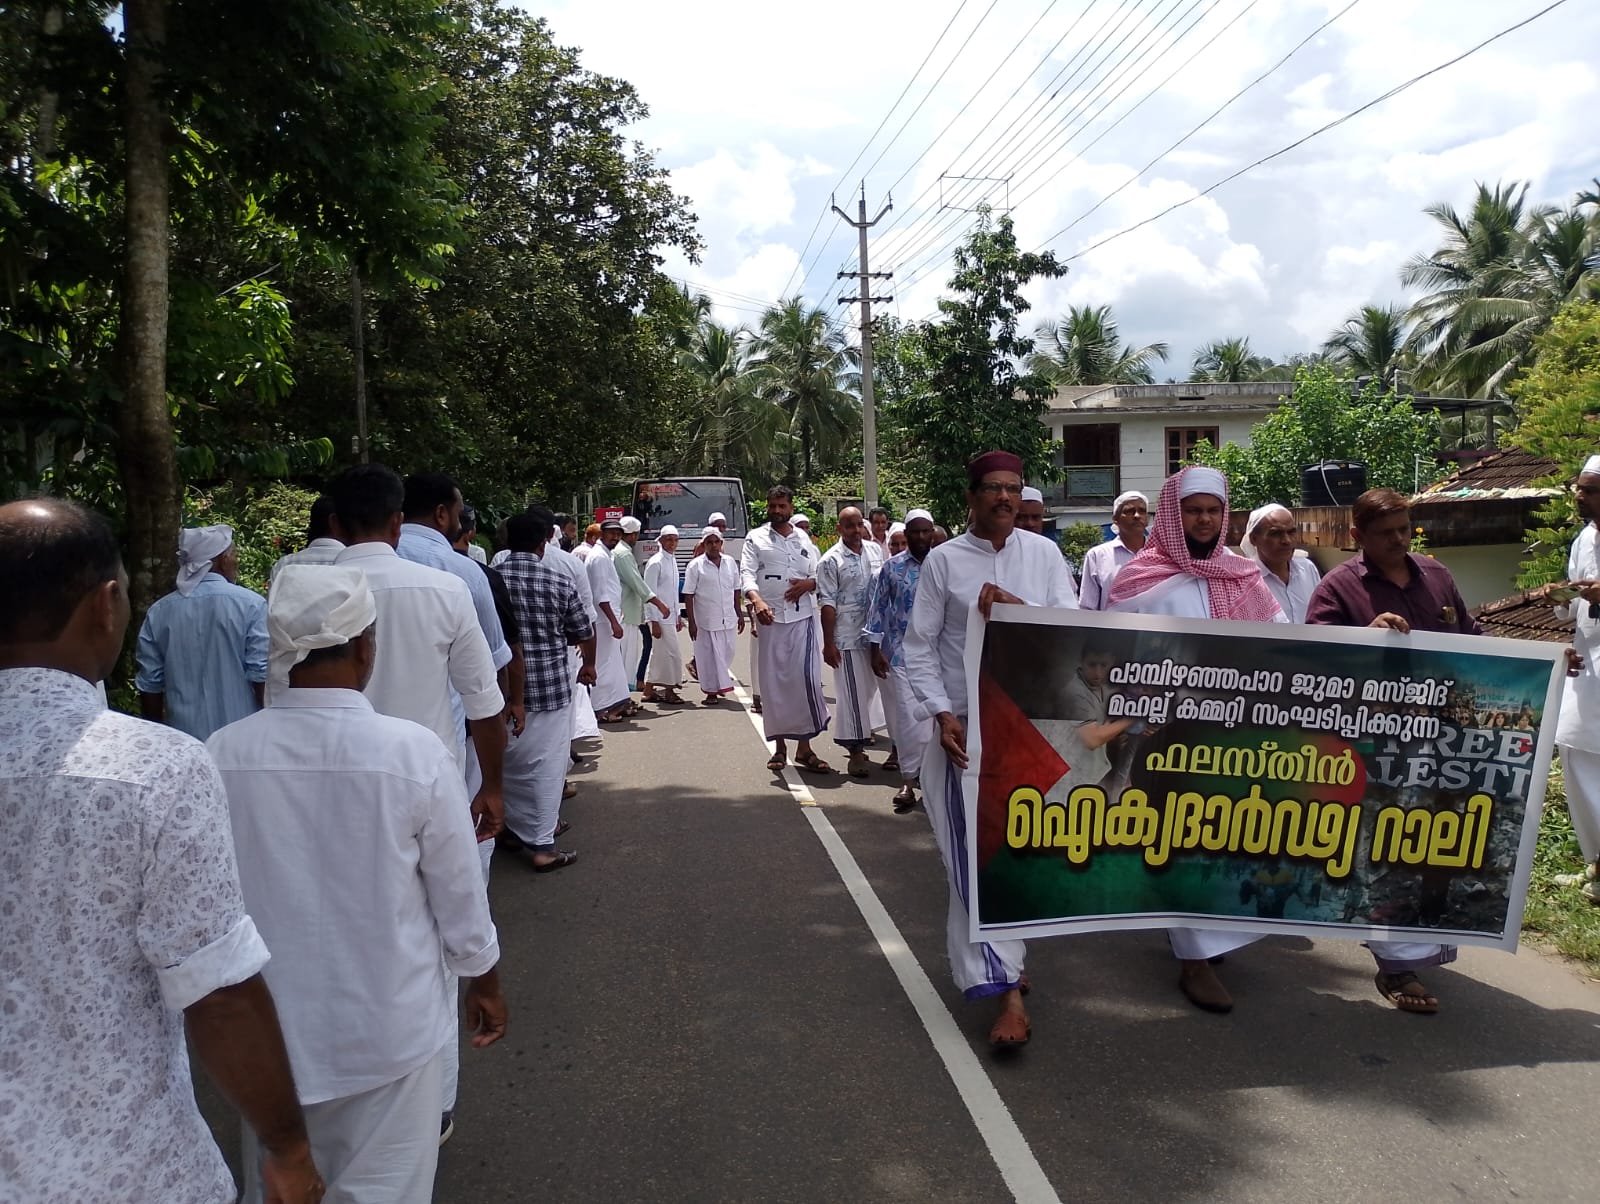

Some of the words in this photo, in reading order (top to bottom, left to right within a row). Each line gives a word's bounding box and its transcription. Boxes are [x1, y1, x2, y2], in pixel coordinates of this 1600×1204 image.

[1109, 659, 1283, 693] പാമ്പിഴഞ്ഞപാറ
[1290, 673, 1355, 703] ജുമാ
[1362, 676, 1455, 707] മസ്ജിദ്
[1108, 692, 1175, 724] മഹല്ല്
[1176, 696, 1246, 728] കമ്മറ്റി
[1252, 702, 1440, 743] സംഘടിപ്പിക്കുന്ന
[1145, 741, 1357, 786] ഫലസ്തീൻ
[1006, 785, 1360, 878] ഐക്യദാർഢ്യ
[1372, 795, 1493, 870] റാലി
